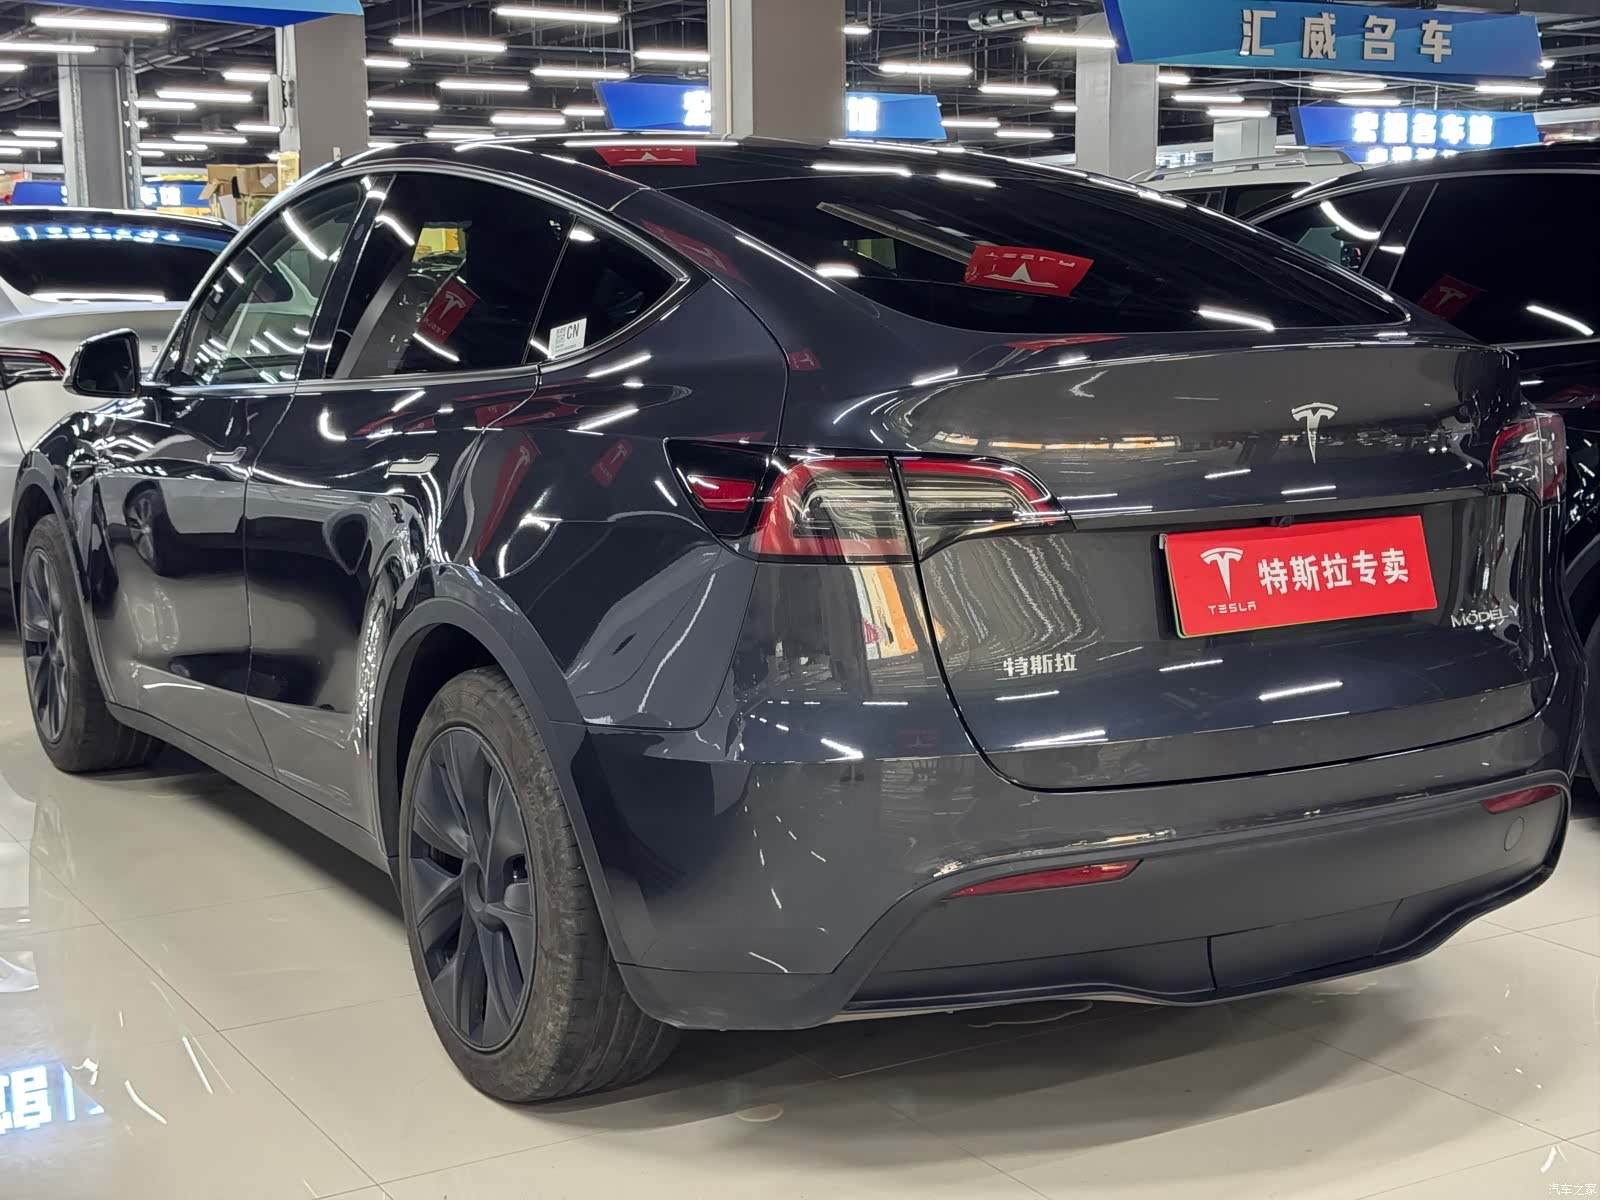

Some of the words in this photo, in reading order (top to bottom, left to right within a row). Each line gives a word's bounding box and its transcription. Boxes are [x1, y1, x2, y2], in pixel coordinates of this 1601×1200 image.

[1240, 8, 1453, 63] 汇威名车
[566, 322, 580, 340] CN
[1257, 548, 1409, 596] 特斯拉专卖
[1208, 601, 1257, 616] TESLA
[1451, 608, 1509, 628] MODEL
[1509, 603, 1520, 617] Y
[1003, 652, 1078, 677] 特斯拉
